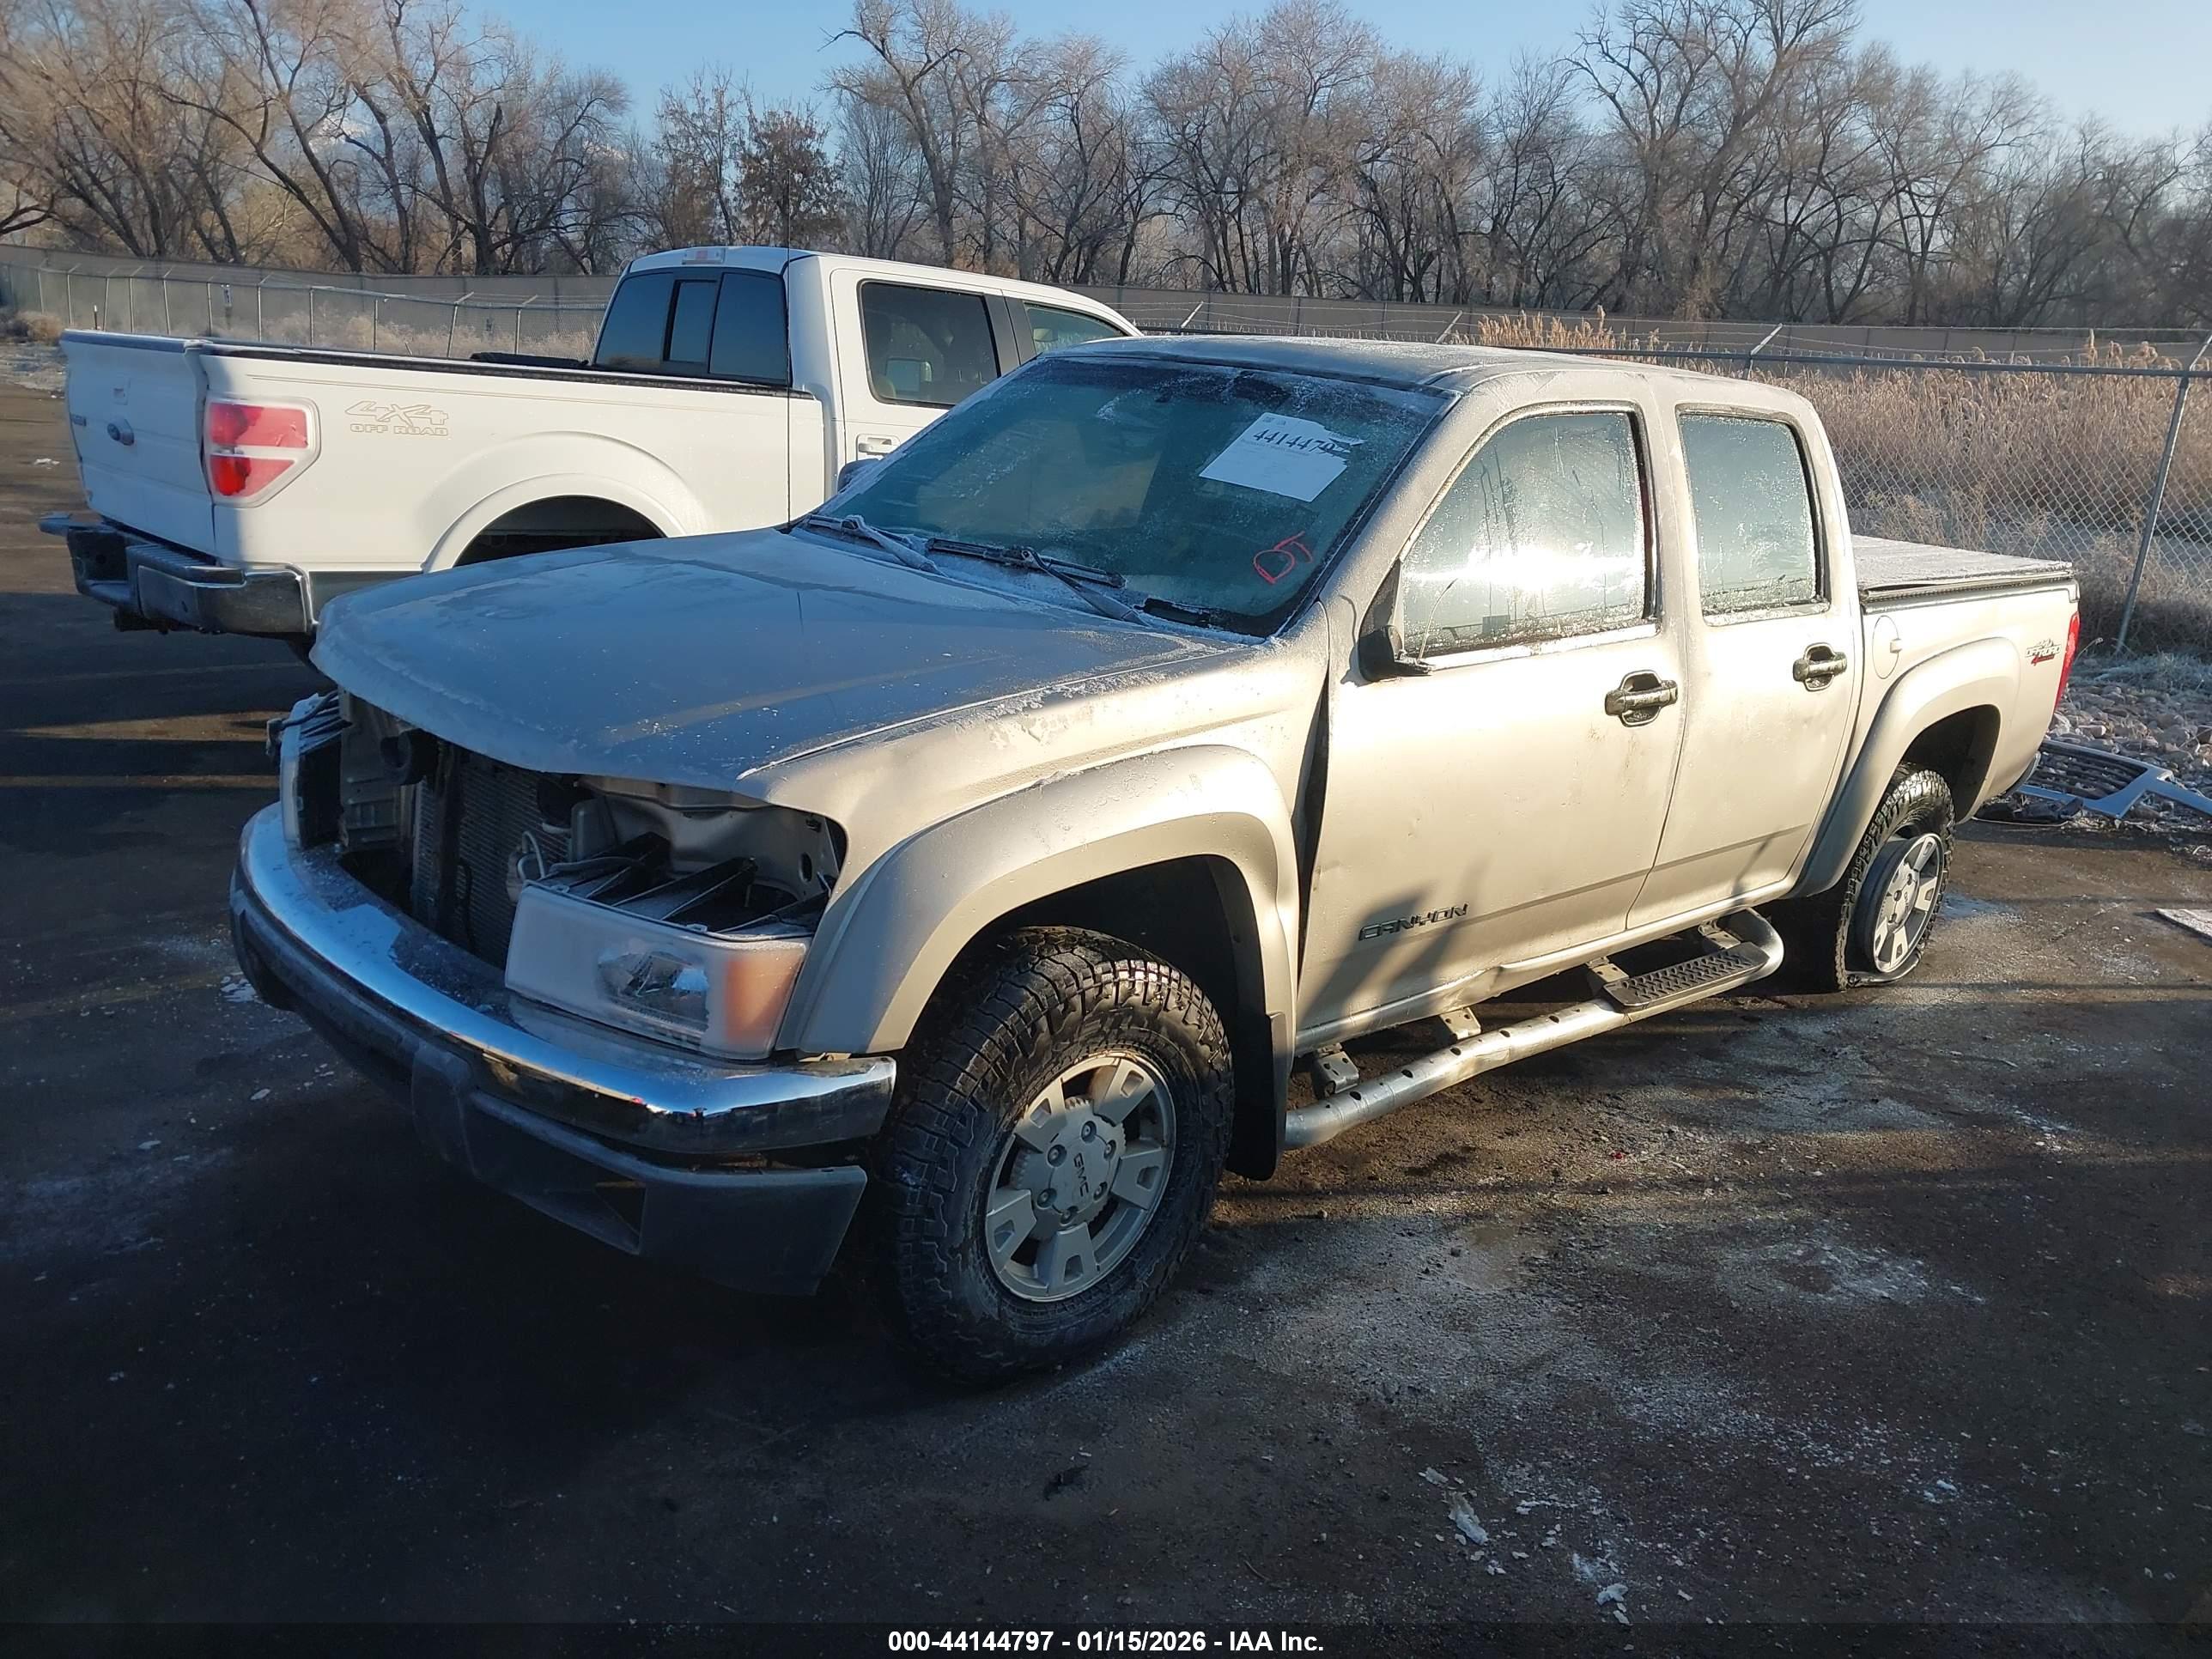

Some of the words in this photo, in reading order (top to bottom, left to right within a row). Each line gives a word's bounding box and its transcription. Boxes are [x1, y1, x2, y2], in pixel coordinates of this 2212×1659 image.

[349, 423, 389, 434] OFF
[393, 425, 449, 436] ROAD
[1358, 902, 1469, 941] CANYON
[1073, 1152, 1089, 1197] GMC
